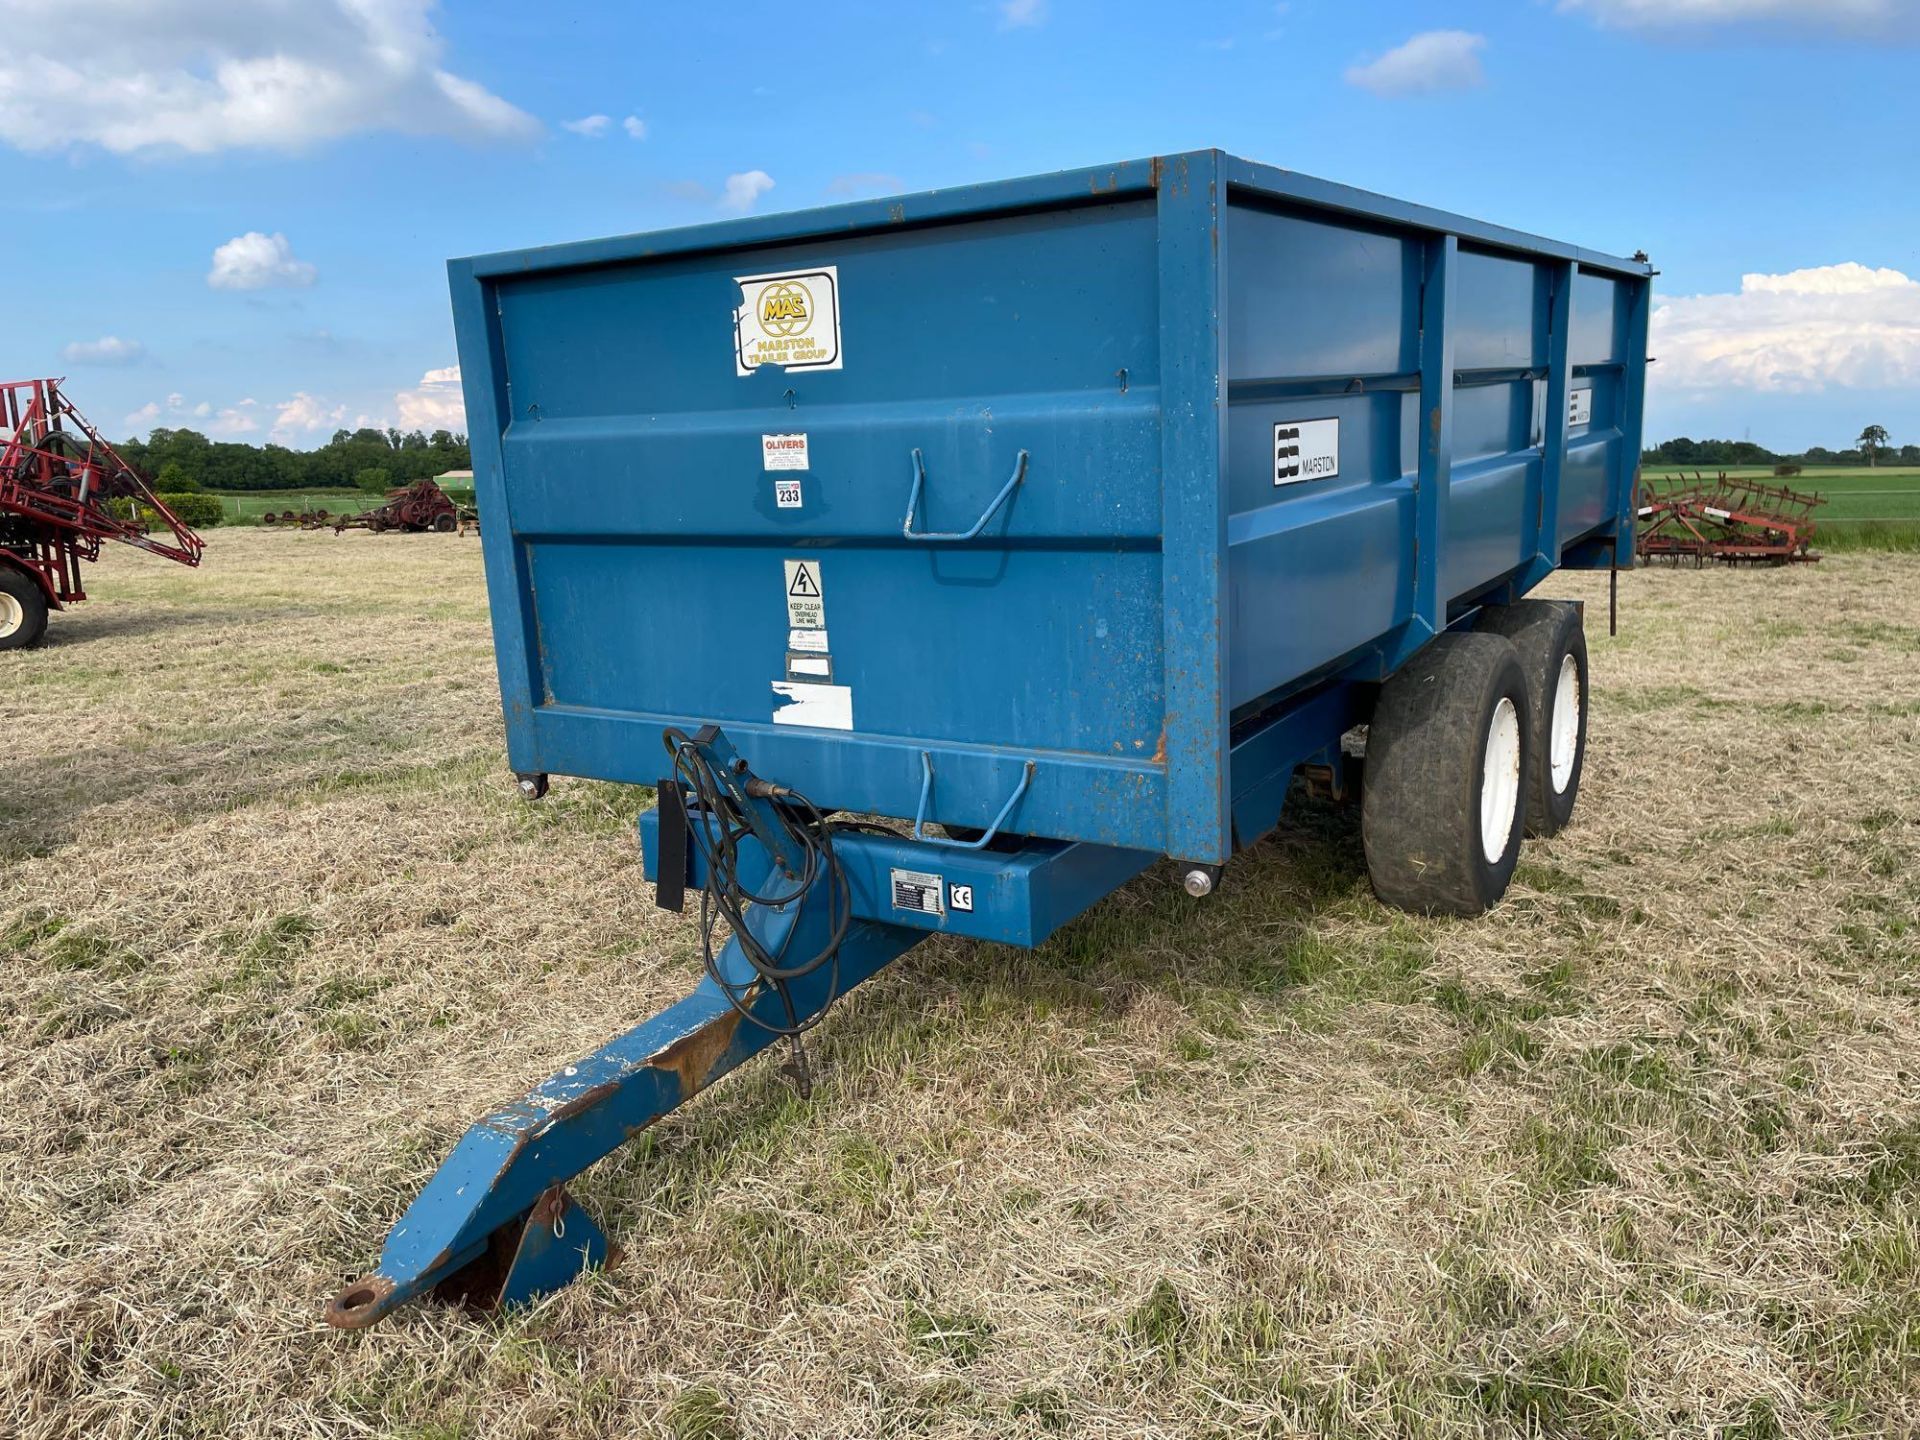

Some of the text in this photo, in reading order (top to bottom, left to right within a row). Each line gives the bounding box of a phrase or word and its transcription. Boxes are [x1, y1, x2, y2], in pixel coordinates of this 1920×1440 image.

[763, 297, 807, 321] MAS
[757, 337, 816, 353] MARSTON
[748, 348, 828, 365] TRAILER GROUP
[765, 440, 805, 450] OLIVERS
[1302, 455, 1336, 475] MARSTON
[779, 489, 800, 502] 233
[804, 603, 821, 611] CLEAR
[953, 889, 970, 906] CE
